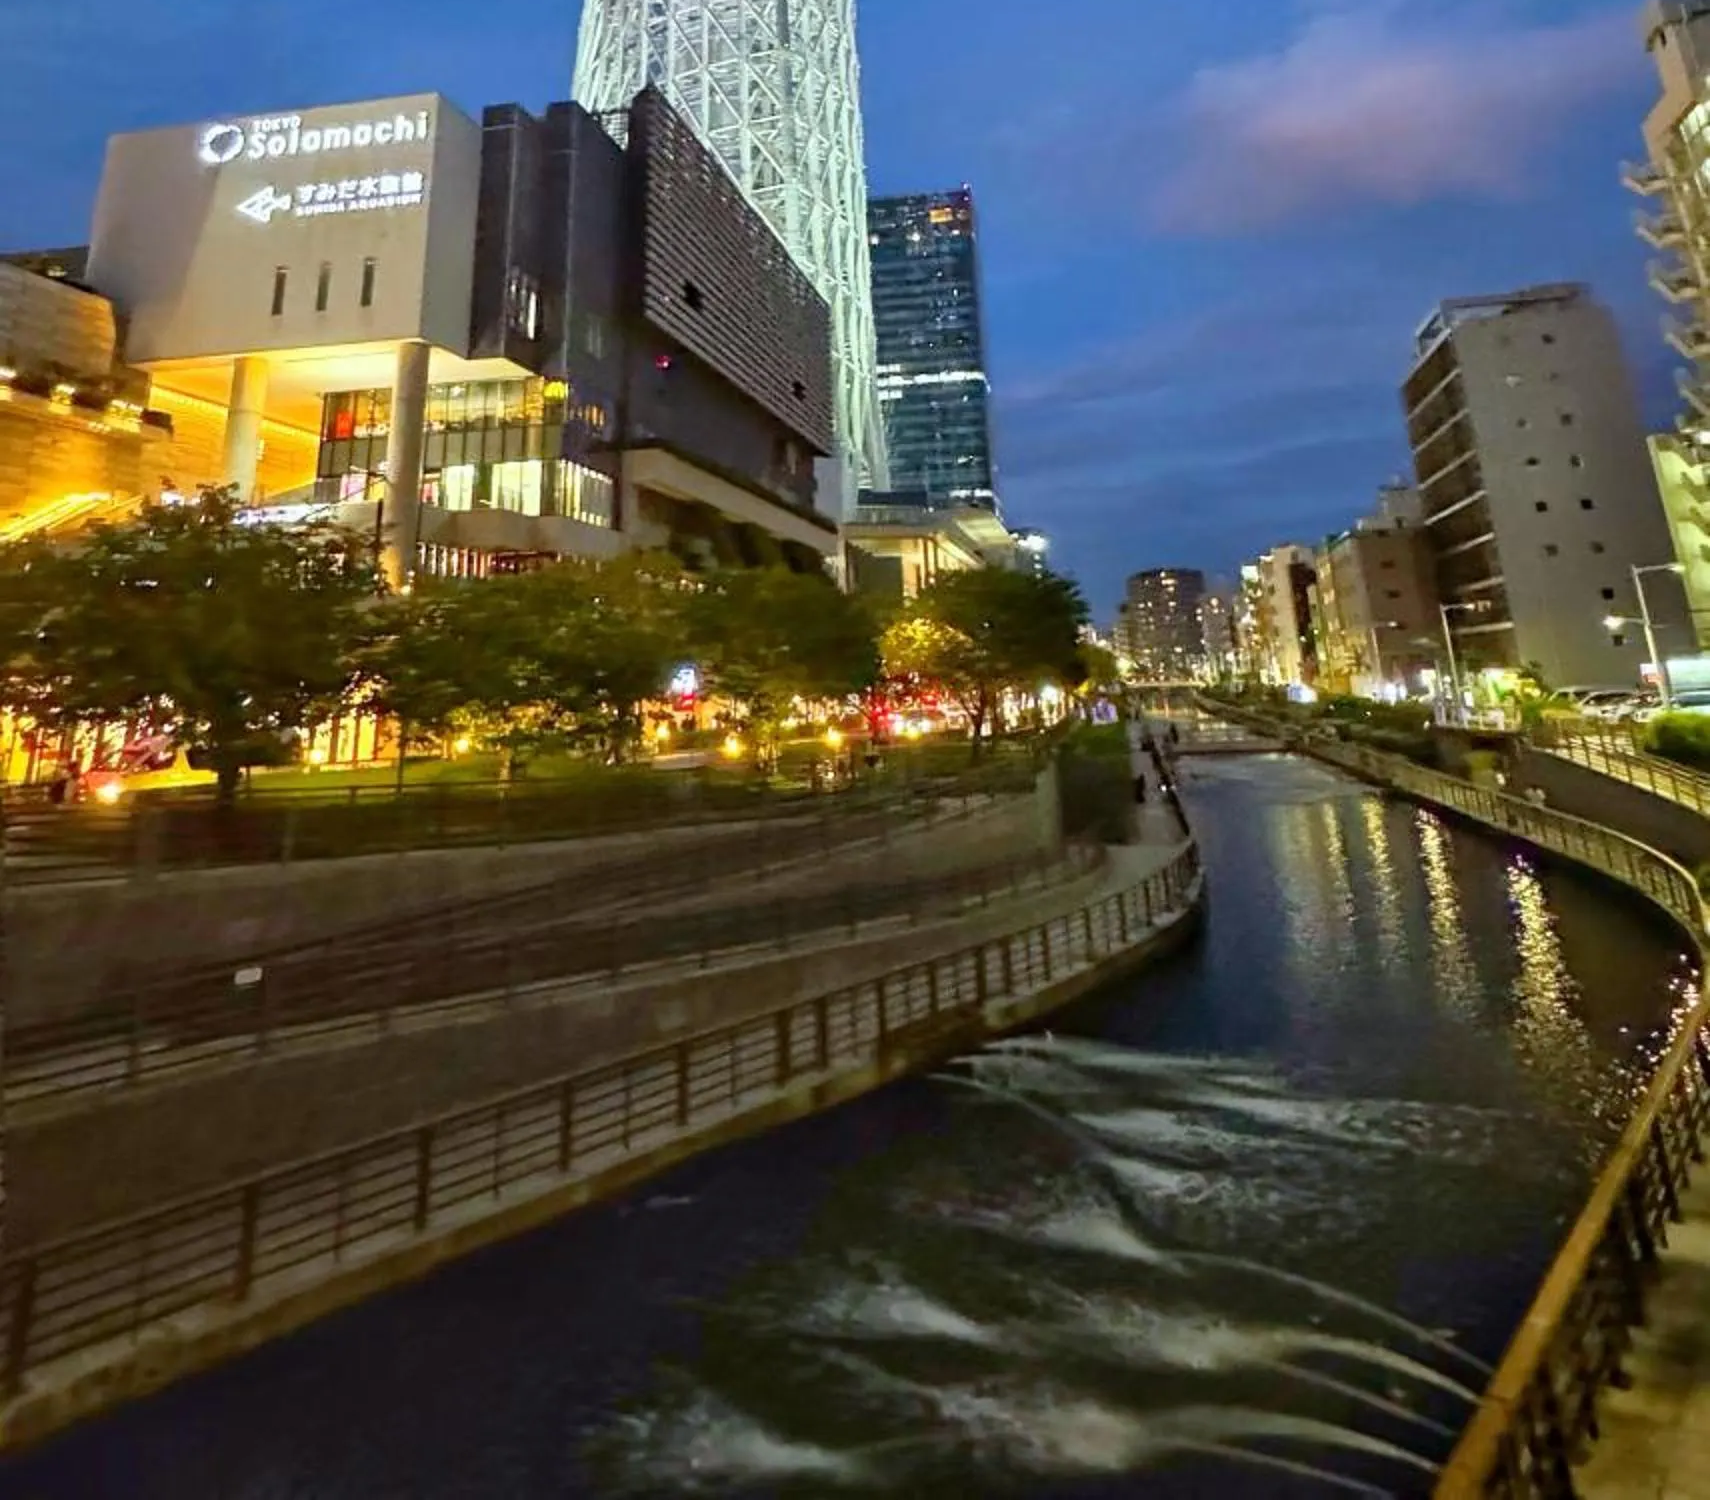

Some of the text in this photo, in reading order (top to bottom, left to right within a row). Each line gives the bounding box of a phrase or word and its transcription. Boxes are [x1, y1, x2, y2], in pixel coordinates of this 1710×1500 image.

[253, 115, 301, 132] TOKYO
[297, 172, 422, 203] すみだ水
